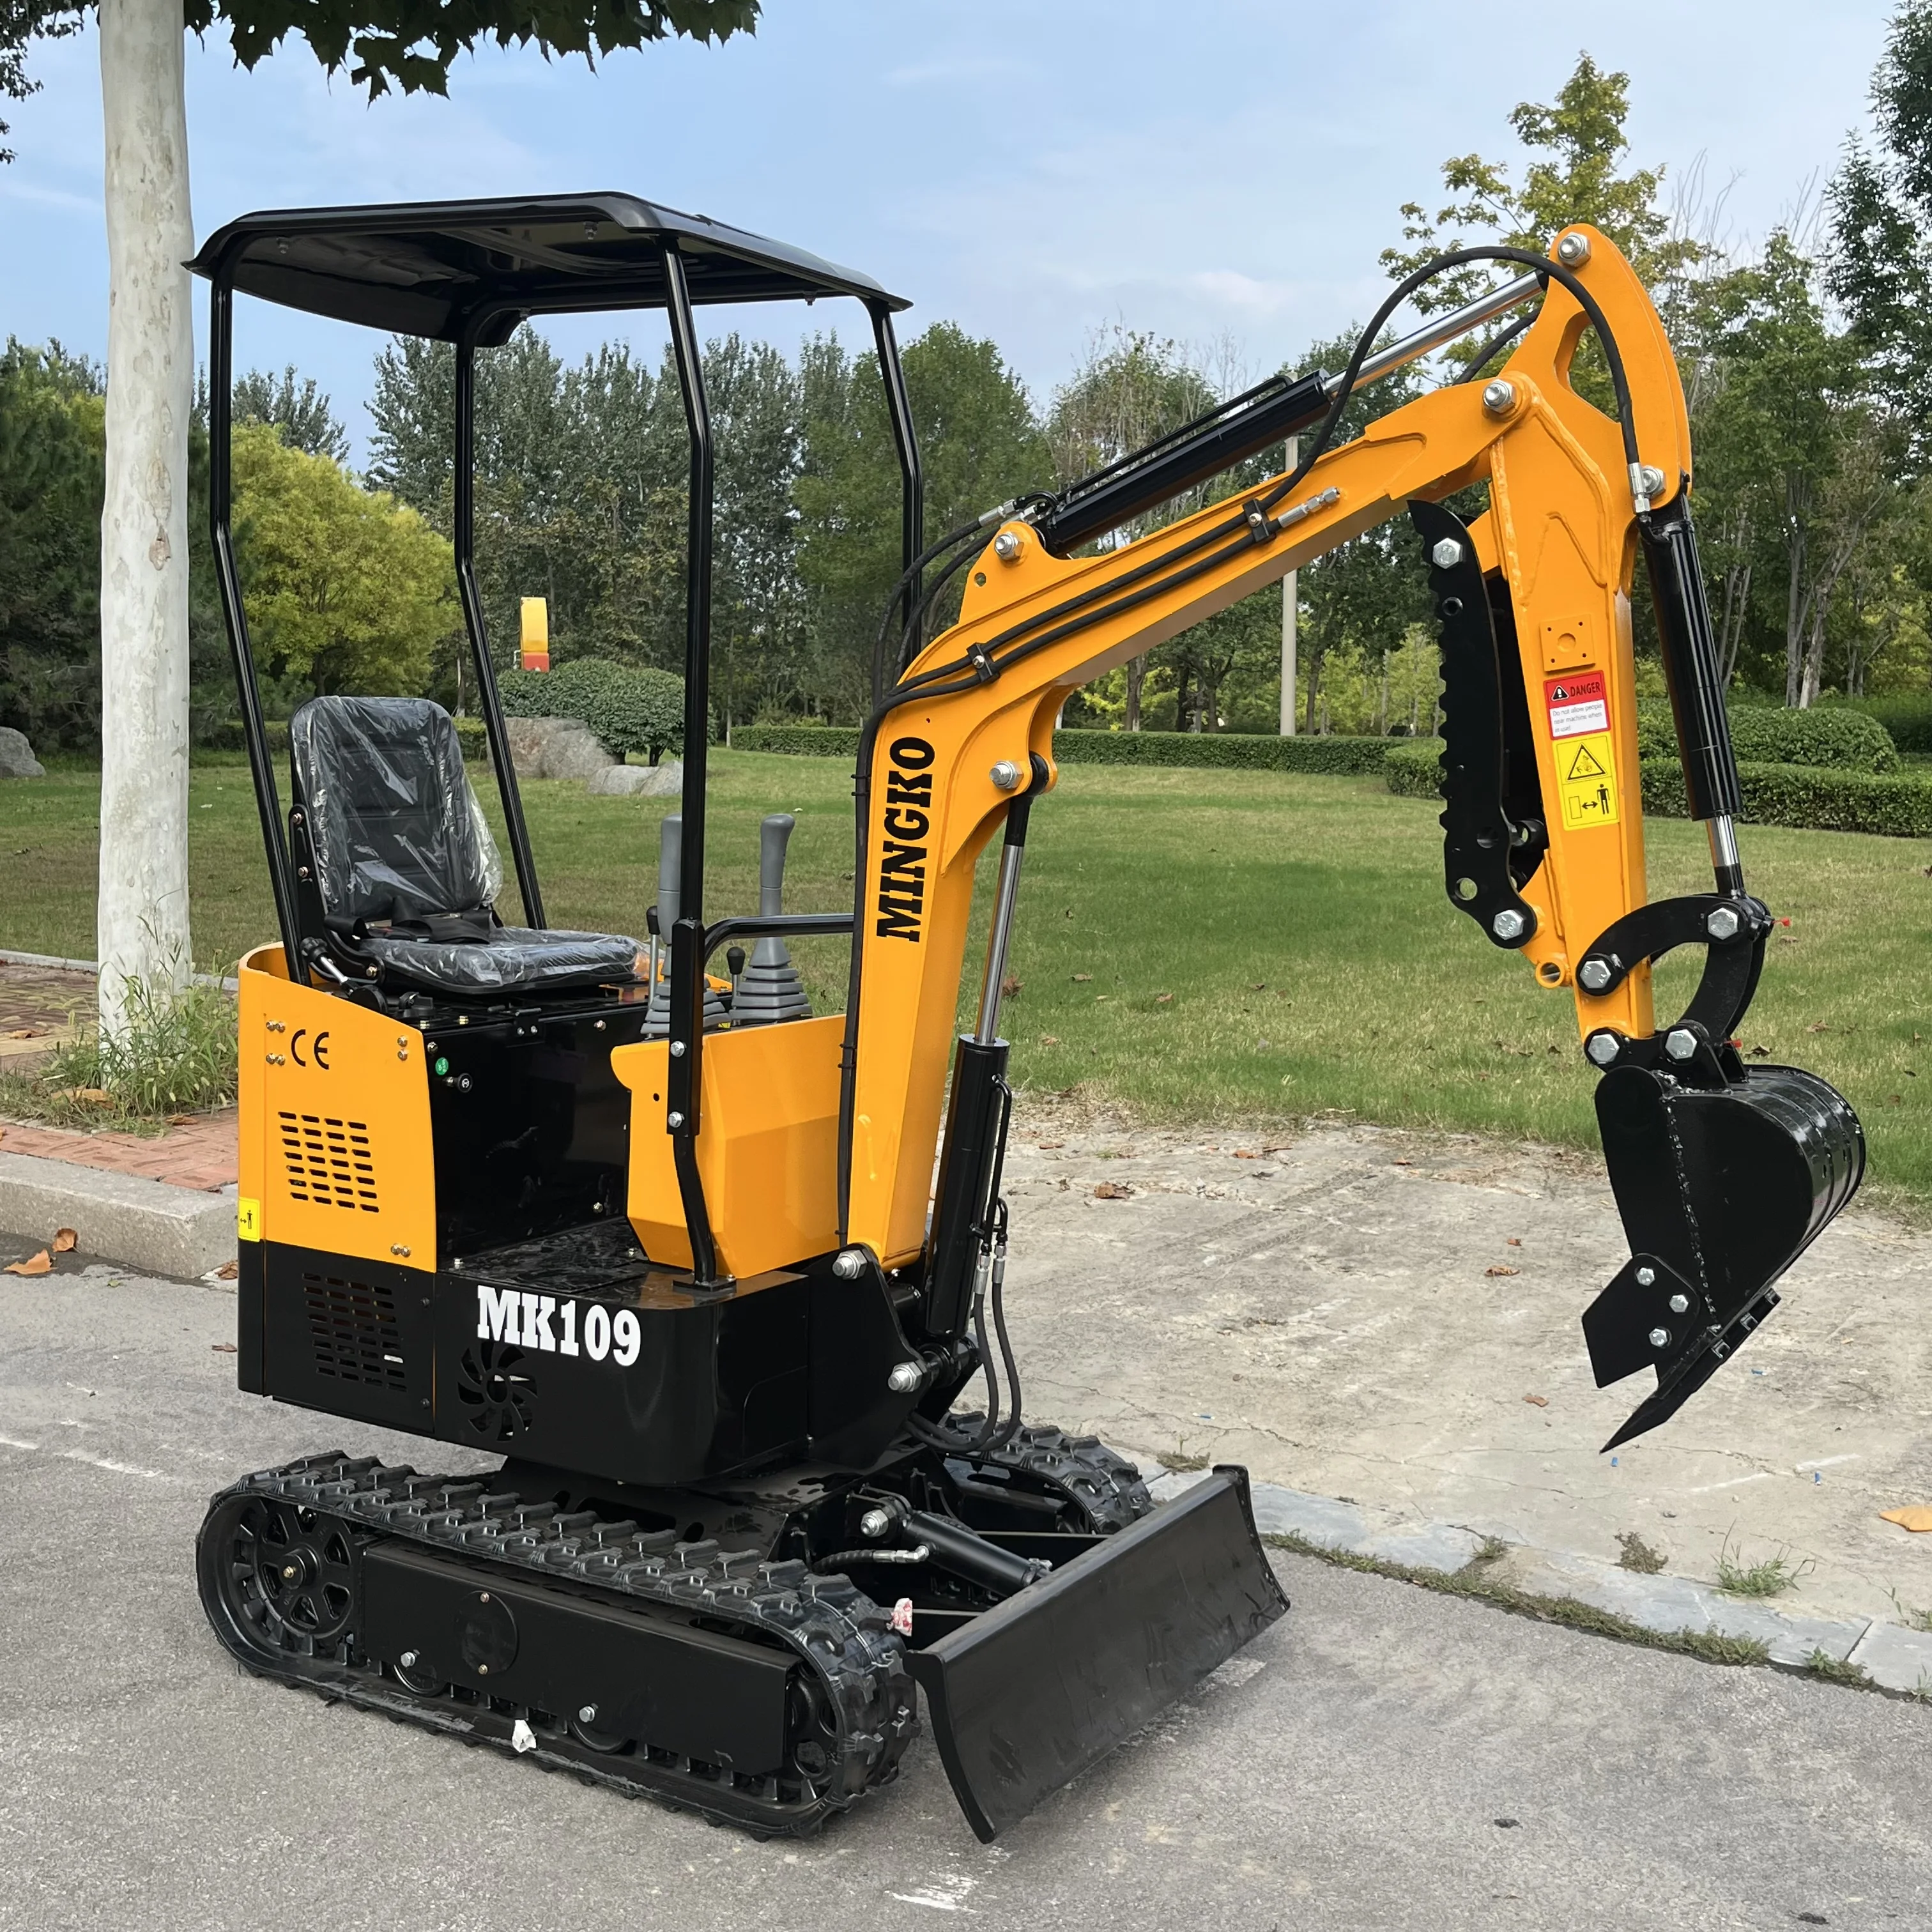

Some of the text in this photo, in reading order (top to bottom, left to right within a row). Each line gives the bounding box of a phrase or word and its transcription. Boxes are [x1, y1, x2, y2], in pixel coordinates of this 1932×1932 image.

[1570, 682, 1601, 697] DANGER
[1585, 703, 1603, 712] people
[876, 737, 935, 943] MINGKO
[291, 1029, 330, 1070] CE
[477, 1285, 641, 1367] MK109
